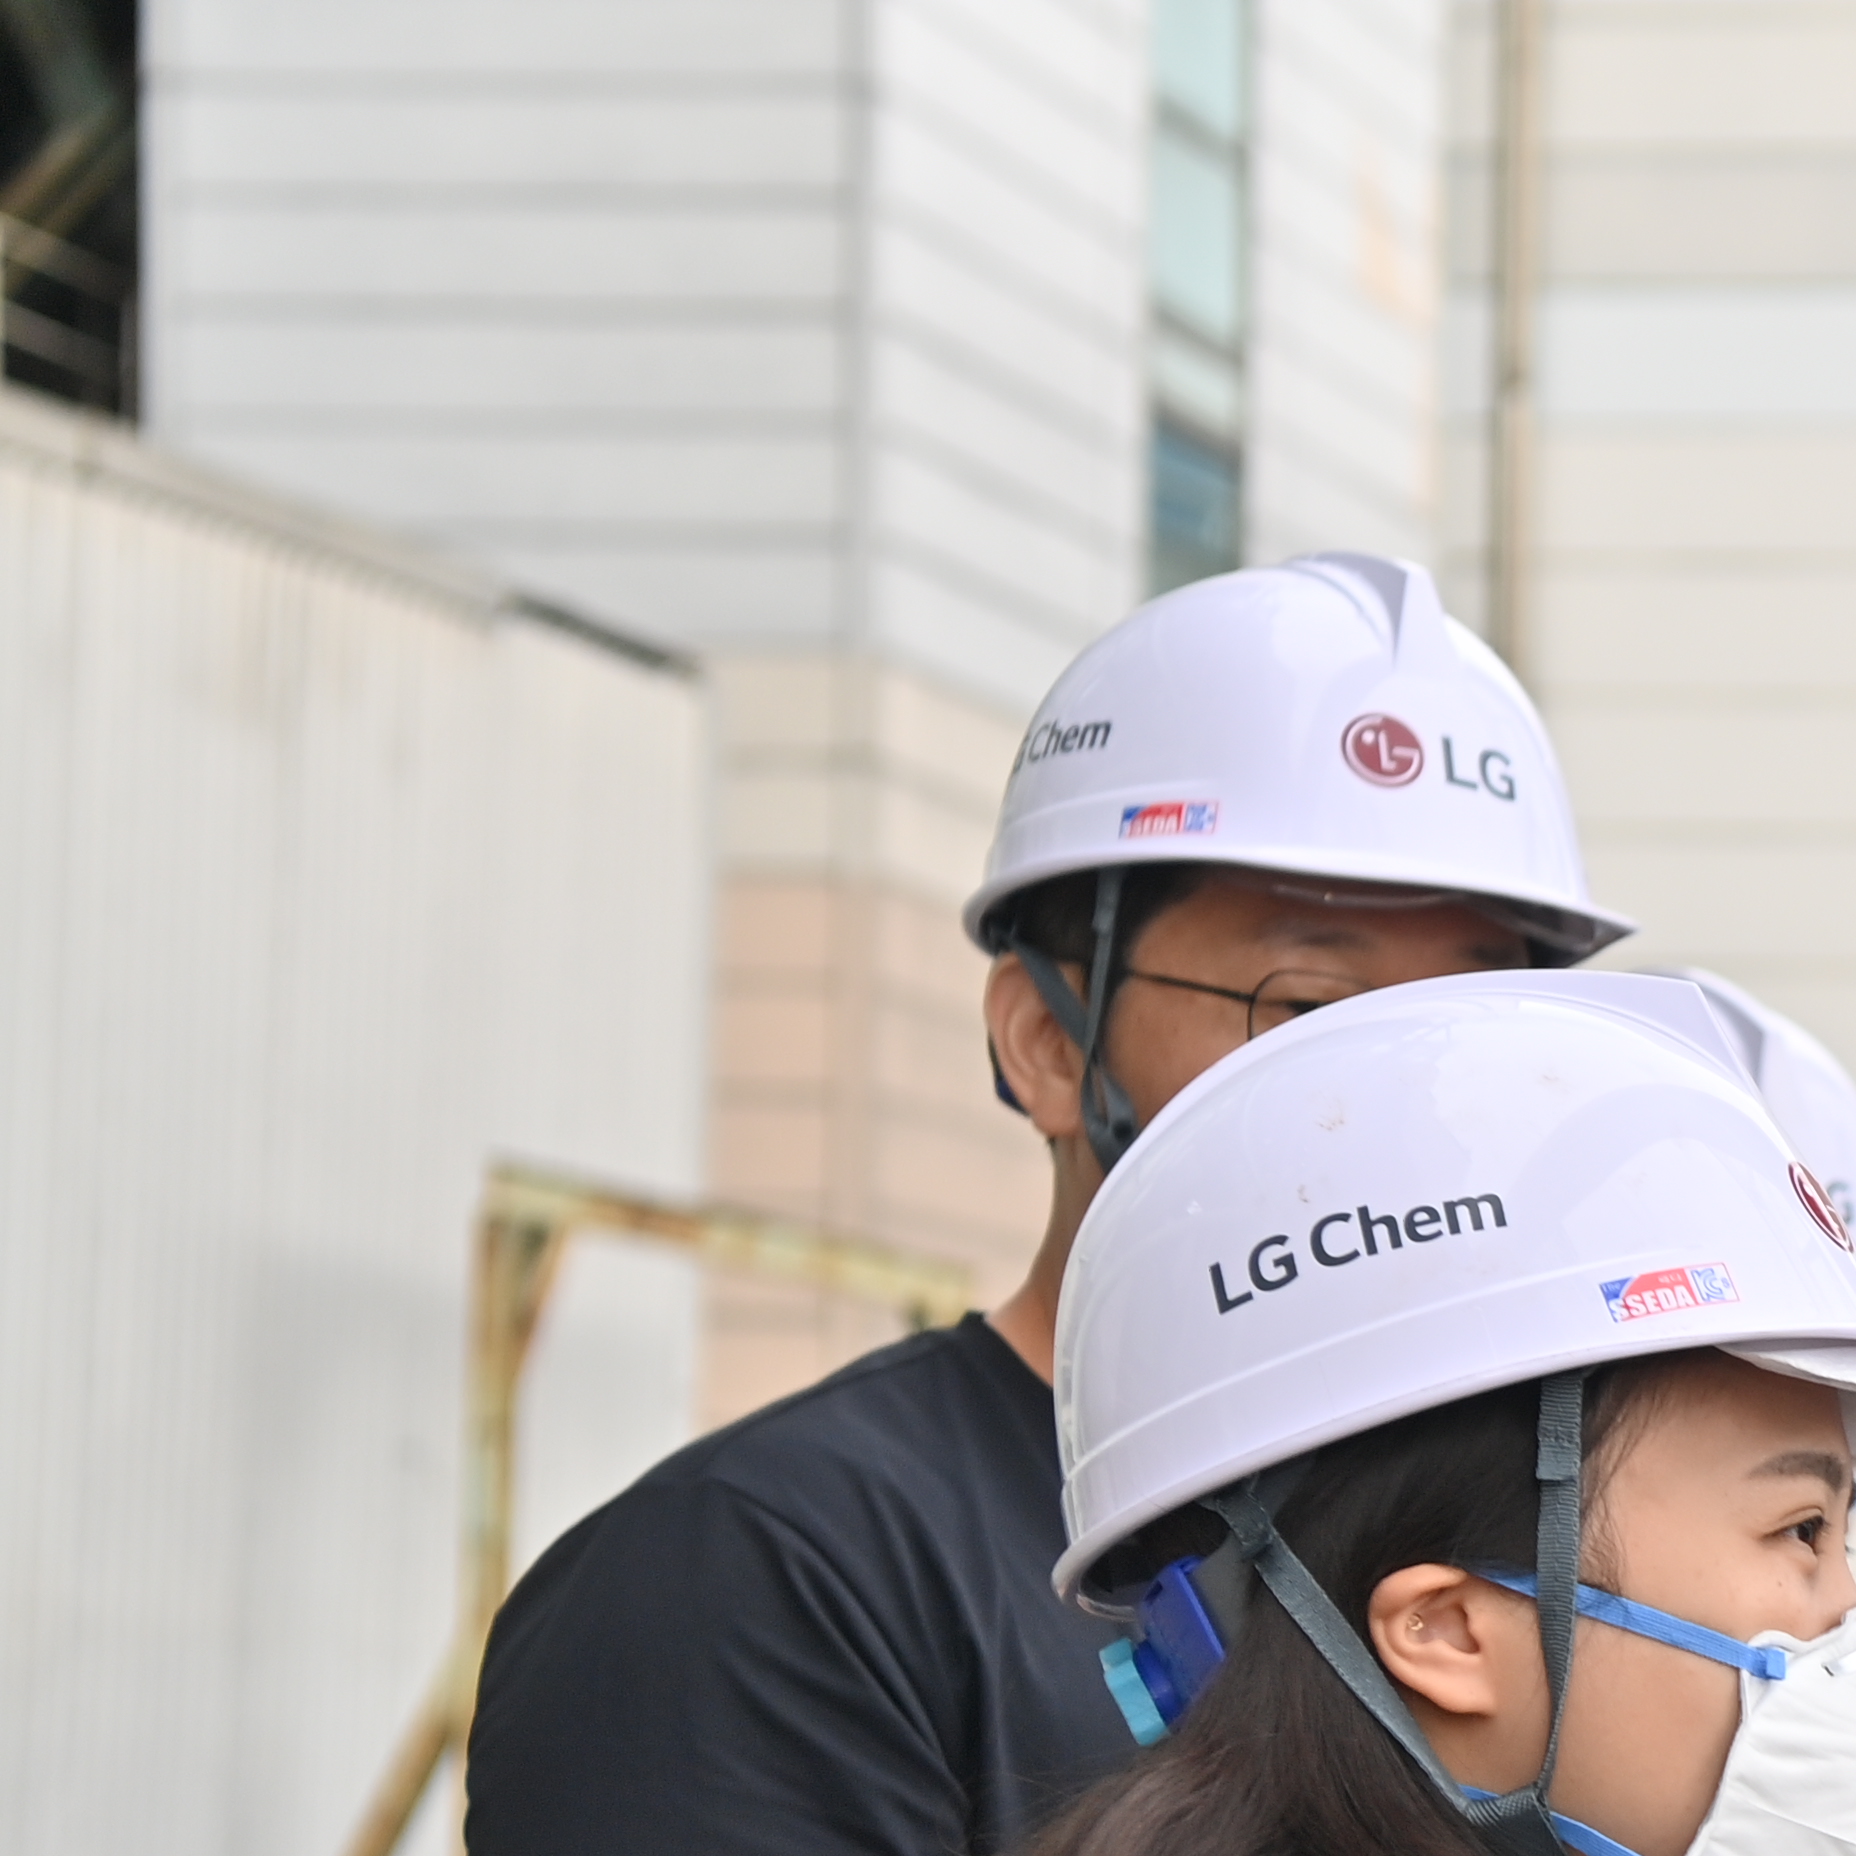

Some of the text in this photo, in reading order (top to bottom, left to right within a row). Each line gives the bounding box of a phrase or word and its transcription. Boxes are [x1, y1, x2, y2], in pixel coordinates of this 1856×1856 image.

[1027, 719, 1112, 765] Chem
[1441, 734, 1516, 802] LG
[1209, 1193, 1508, 1315] LG Chem
[1608, 1284, 1696, 1321] SSEDA
